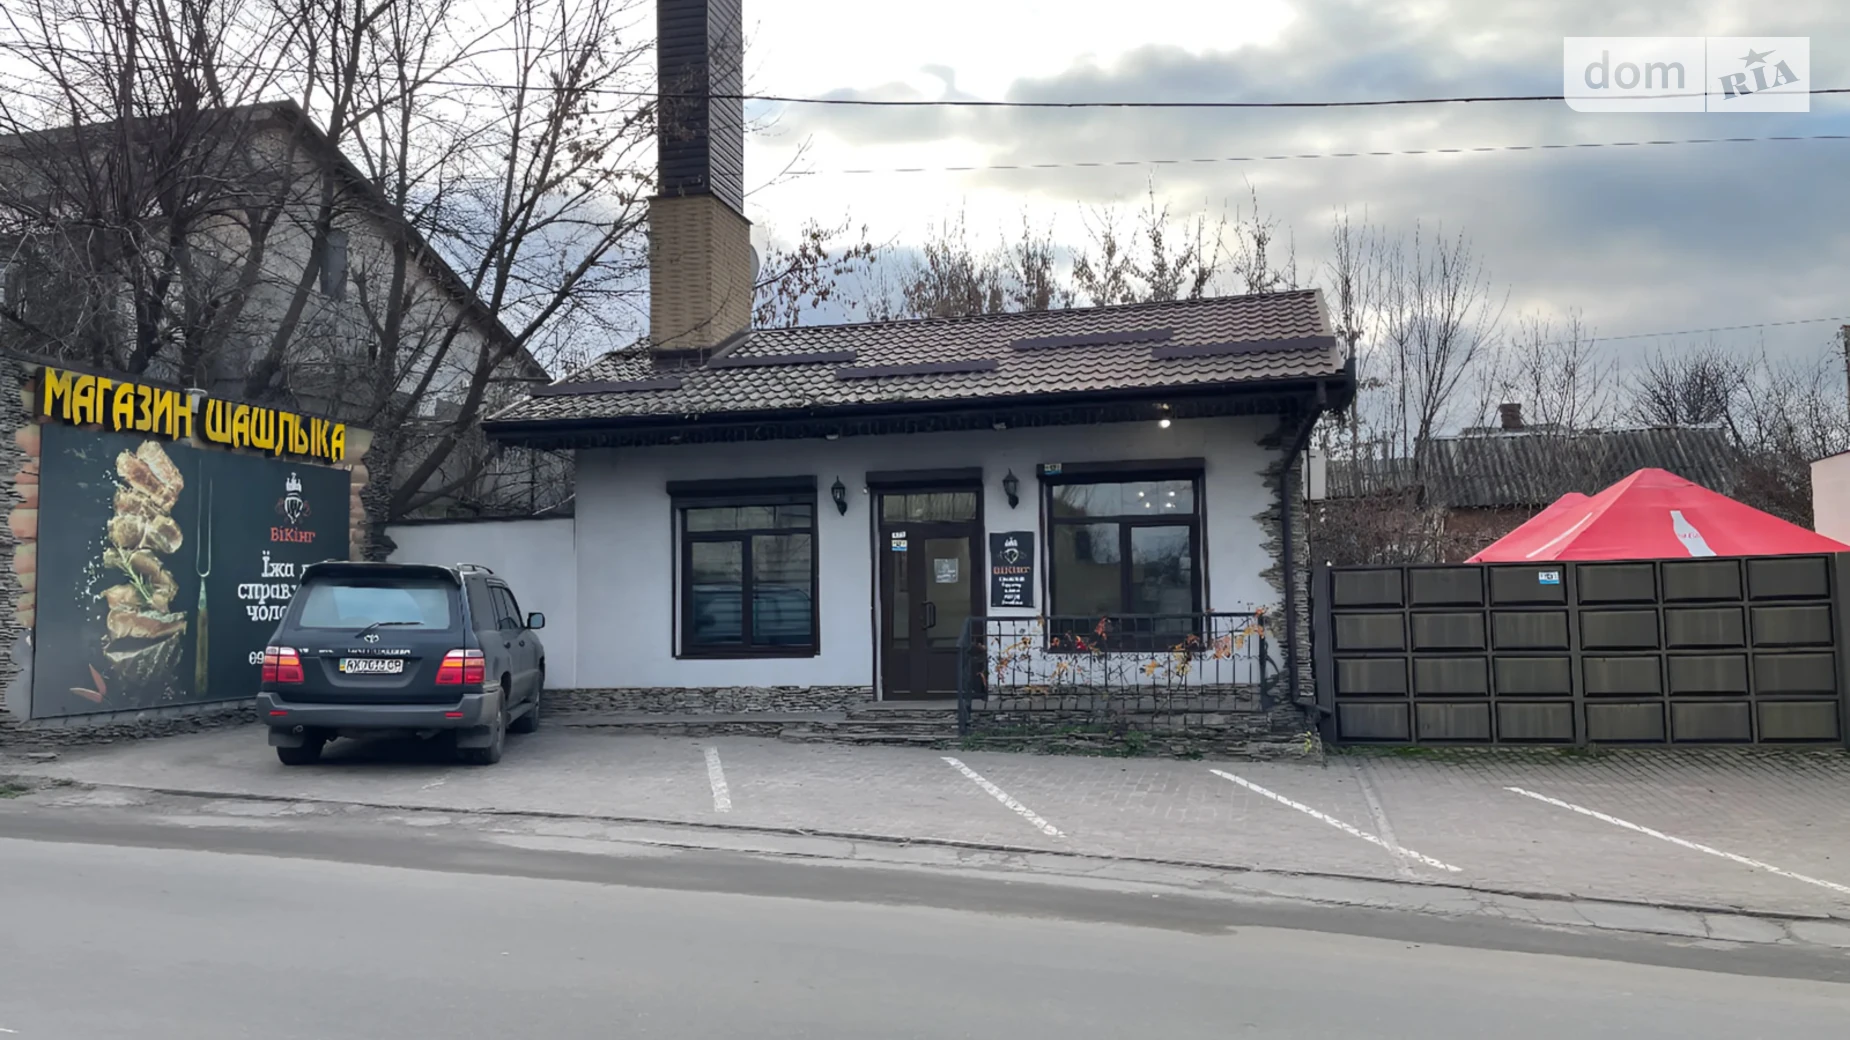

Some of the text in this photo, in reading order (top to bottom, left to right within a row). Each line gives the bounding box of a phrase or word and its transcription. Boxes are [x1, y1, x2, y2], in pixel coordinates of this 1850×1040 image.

[43, 367, 346, 463] МАГАЗИН ШАШЛЫКА
[261, 550, 295, 577] Їжа
[238, 583, 297, 604] справ
